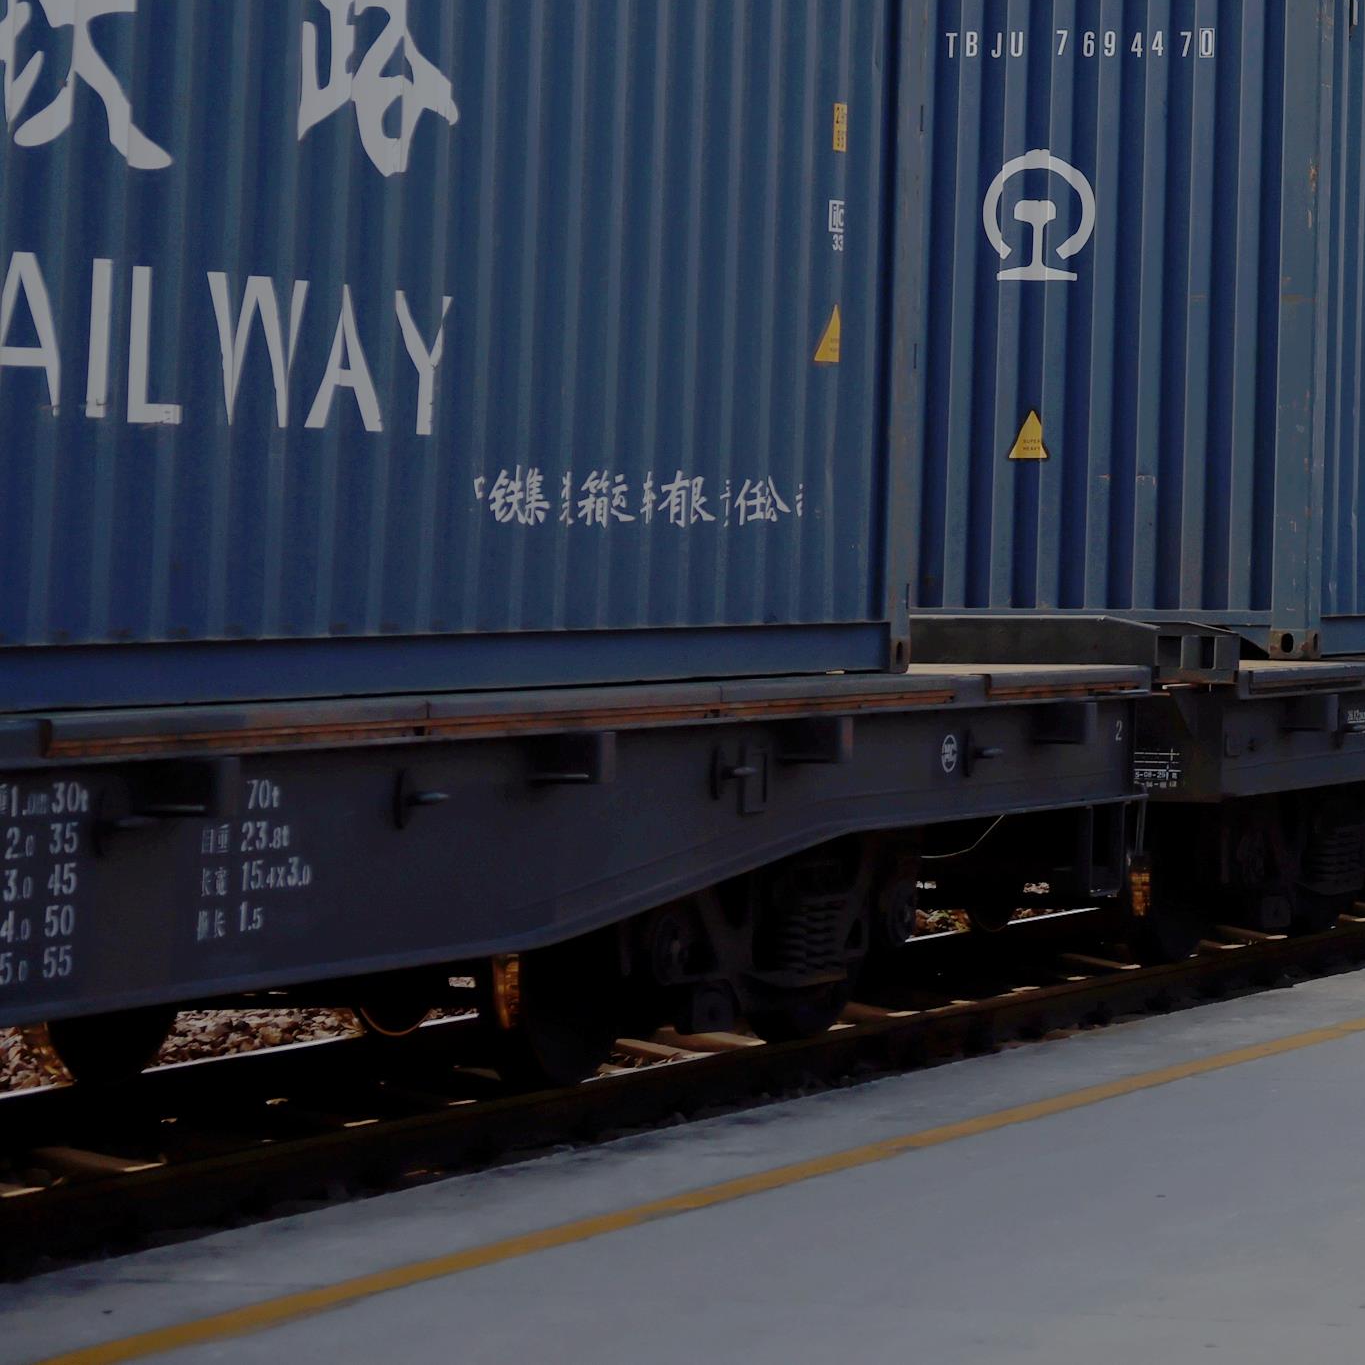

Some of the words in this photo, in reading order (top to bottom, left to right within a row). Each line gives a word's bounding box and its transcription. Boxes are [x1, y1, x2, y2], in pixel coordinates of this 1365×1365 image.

[945, 30, 1025, 59] TBJU
[1055, 27, 1216, 59] 7694470
[48, 821, 80, 855] 35
[2, 868, 34, 903] 3.0
[47, 862, 78, 897] 45
[44, 904, 76, 938] 50
[239, 901, 265, 932] 1.5
[42, 944, 73, 979] 55
